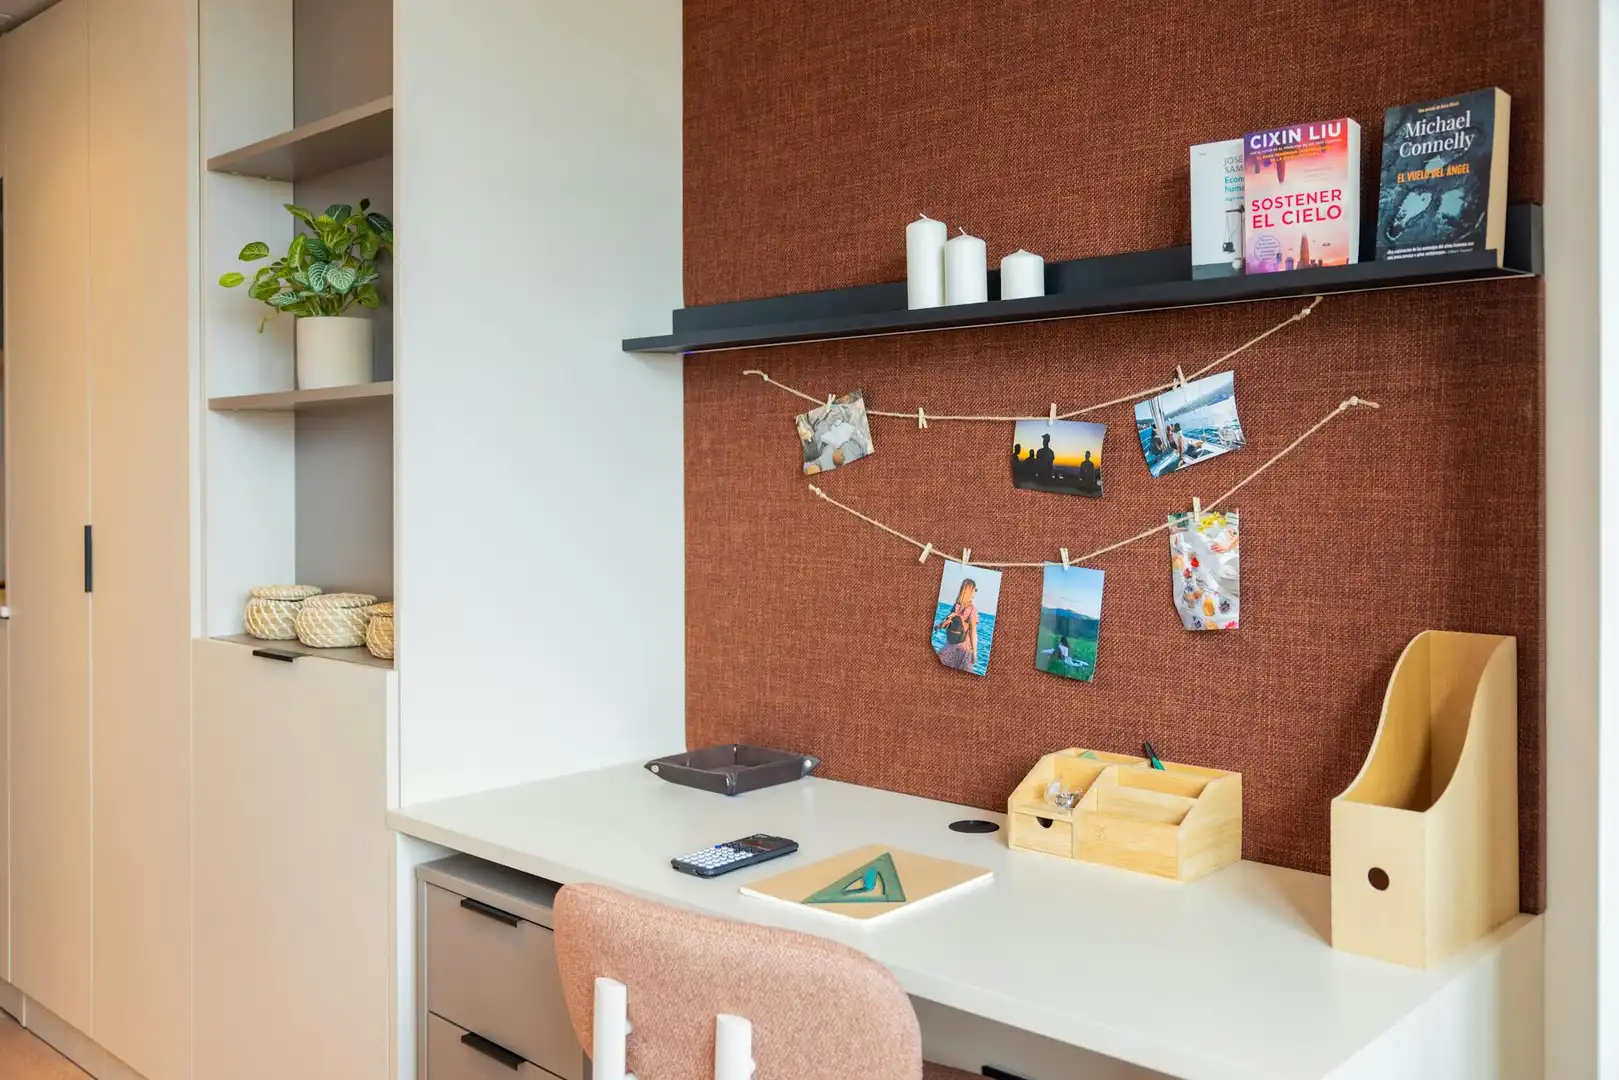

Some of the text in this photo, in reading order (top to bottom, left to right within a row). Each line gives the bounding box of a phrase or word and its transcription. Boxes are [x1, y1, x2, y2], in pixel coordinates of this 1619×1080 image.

[1250, 127, 1301, 149] CIXIN
[1309, 122, 1341, 141] LIU
[1404, 109, 1471, 139] Michael
[1399, 131, 1475, 158] Connelly
[1397, 172, 1405, 184] EL
[1407, 169, 1430, 182] VUELO
[1431, 166, 1445, 179] DEL
[1251, 189, 1342, 212] SOSTENER
[1252, 205, 1342, 229] EL CIELO
